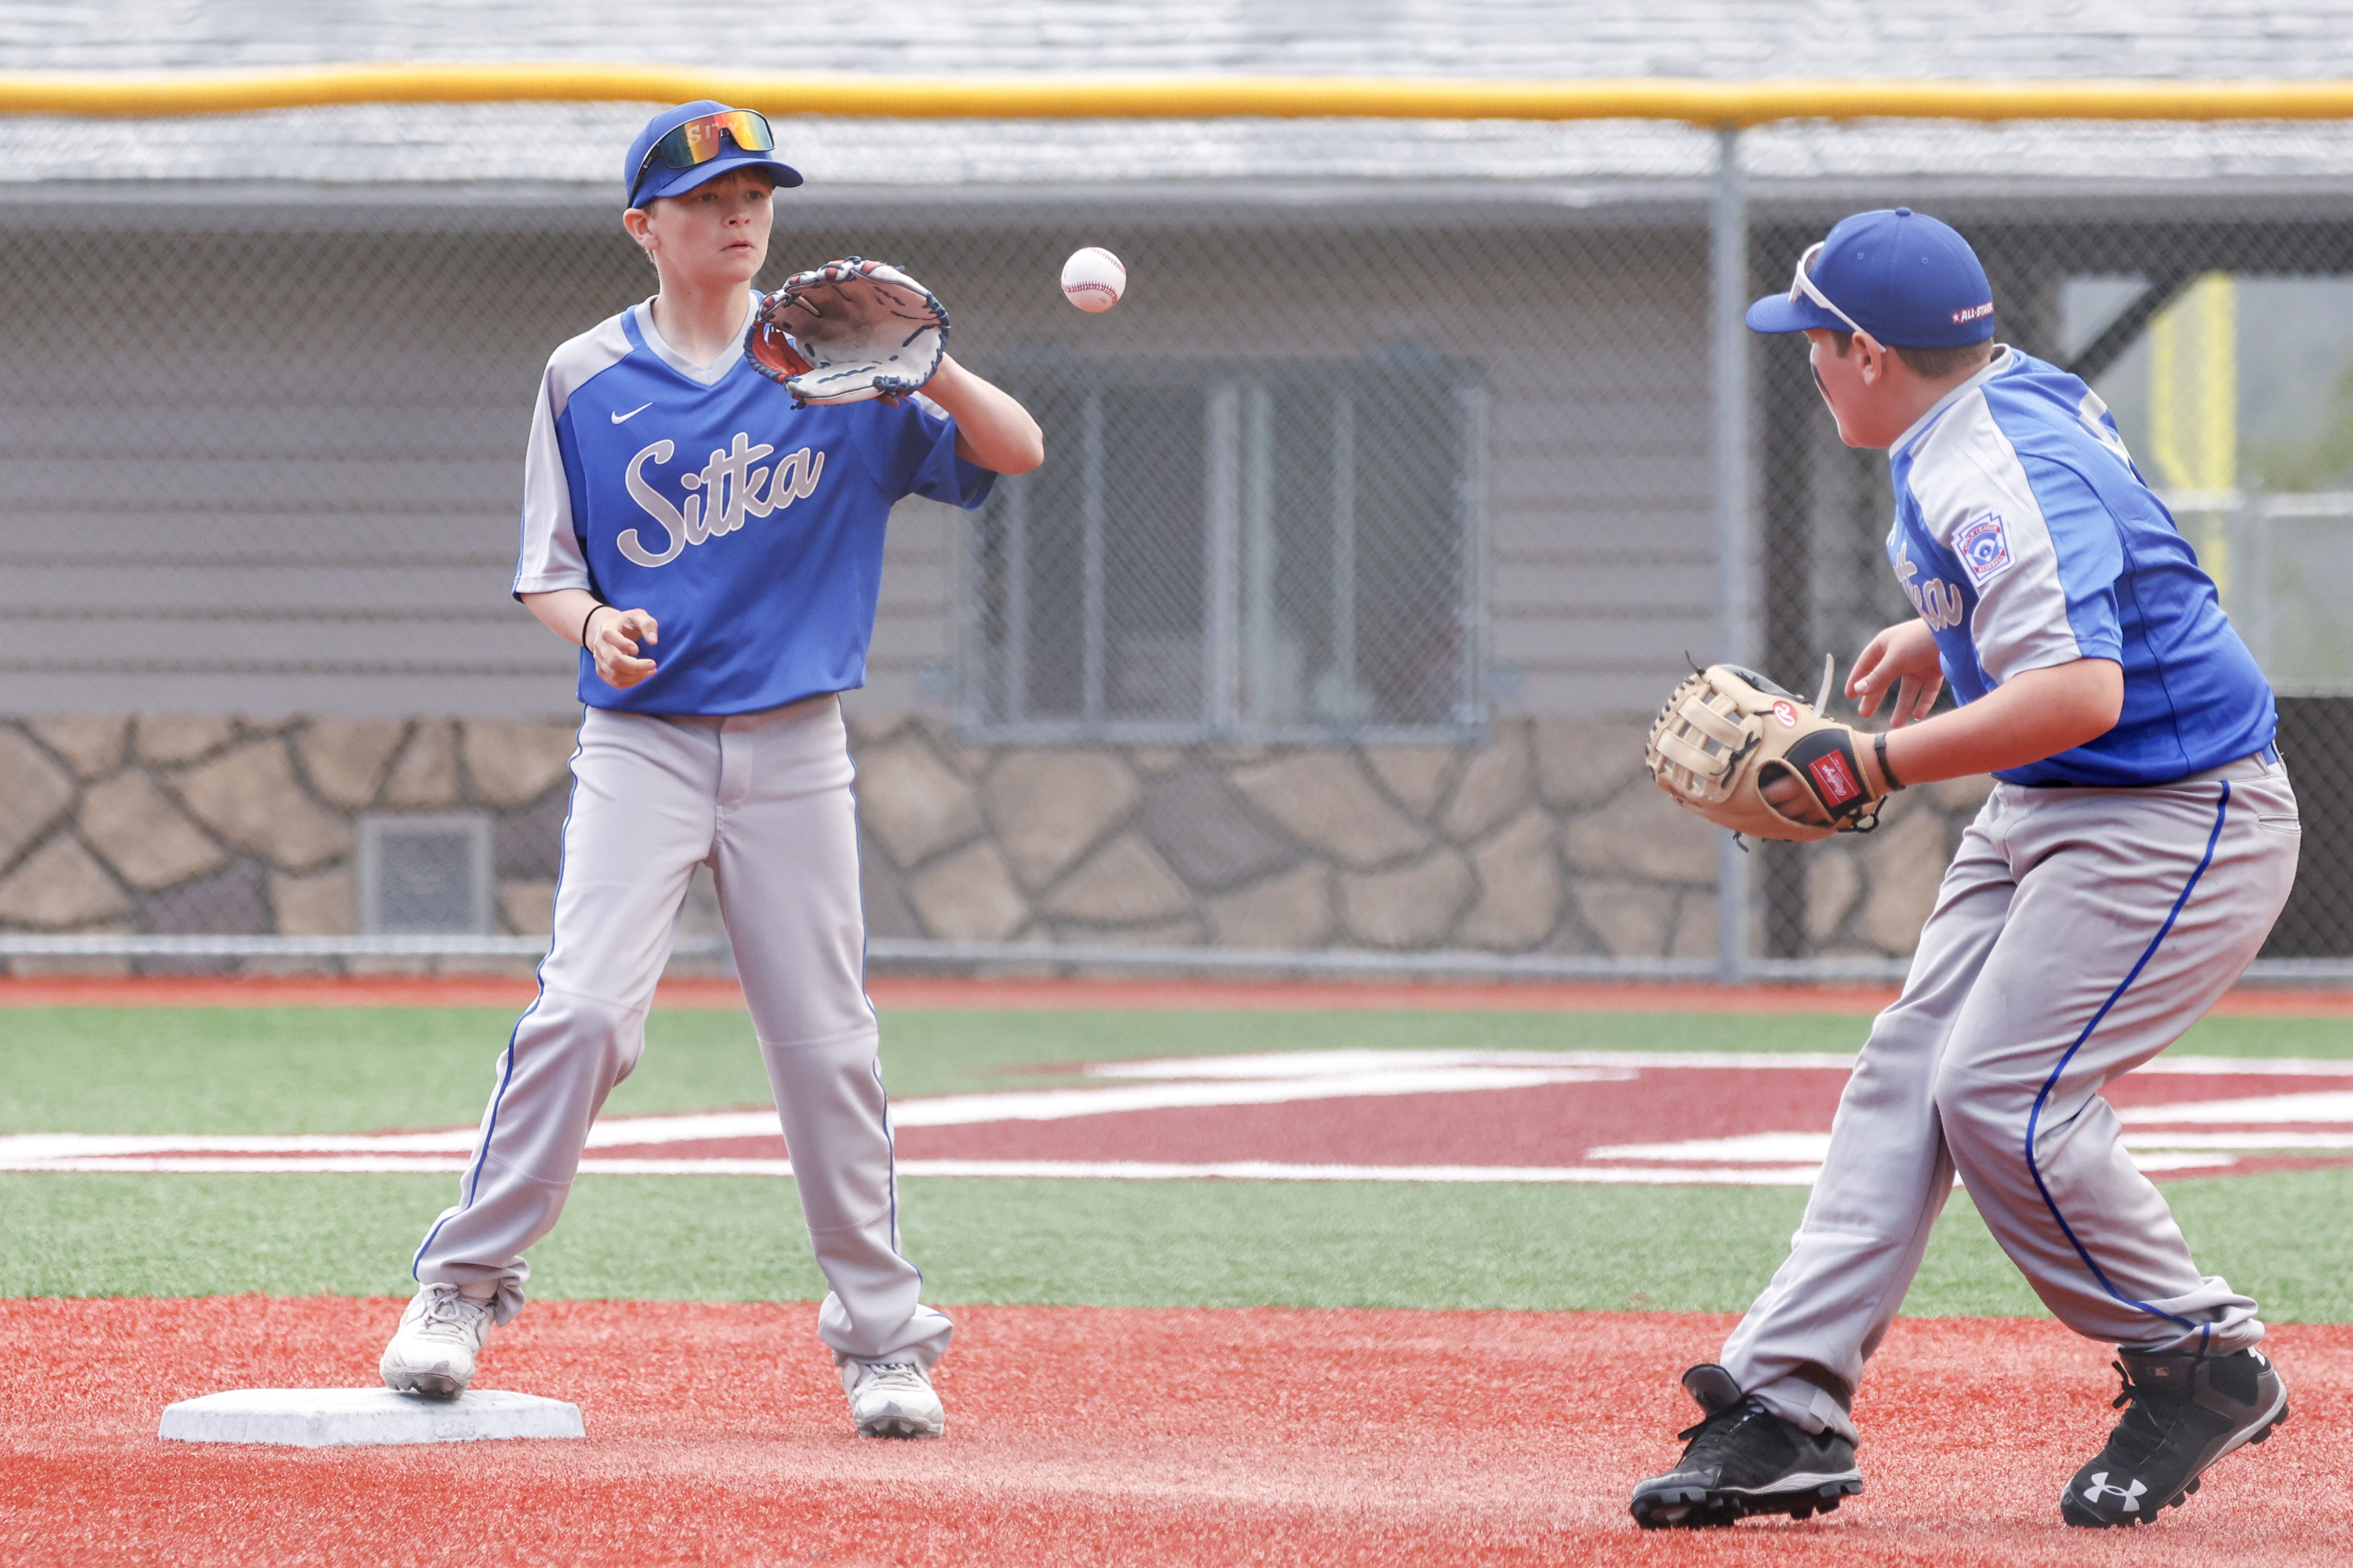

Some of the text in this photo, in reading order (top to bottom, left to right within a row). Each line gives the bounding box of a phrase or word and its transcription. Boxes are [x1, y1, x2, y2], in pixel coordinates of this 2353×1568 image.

[616, 432, 825, 568] Sitka
[1978, 556, 2001, 573] BASEBALL
[1822, 765, 1847, 796] Rawlings
